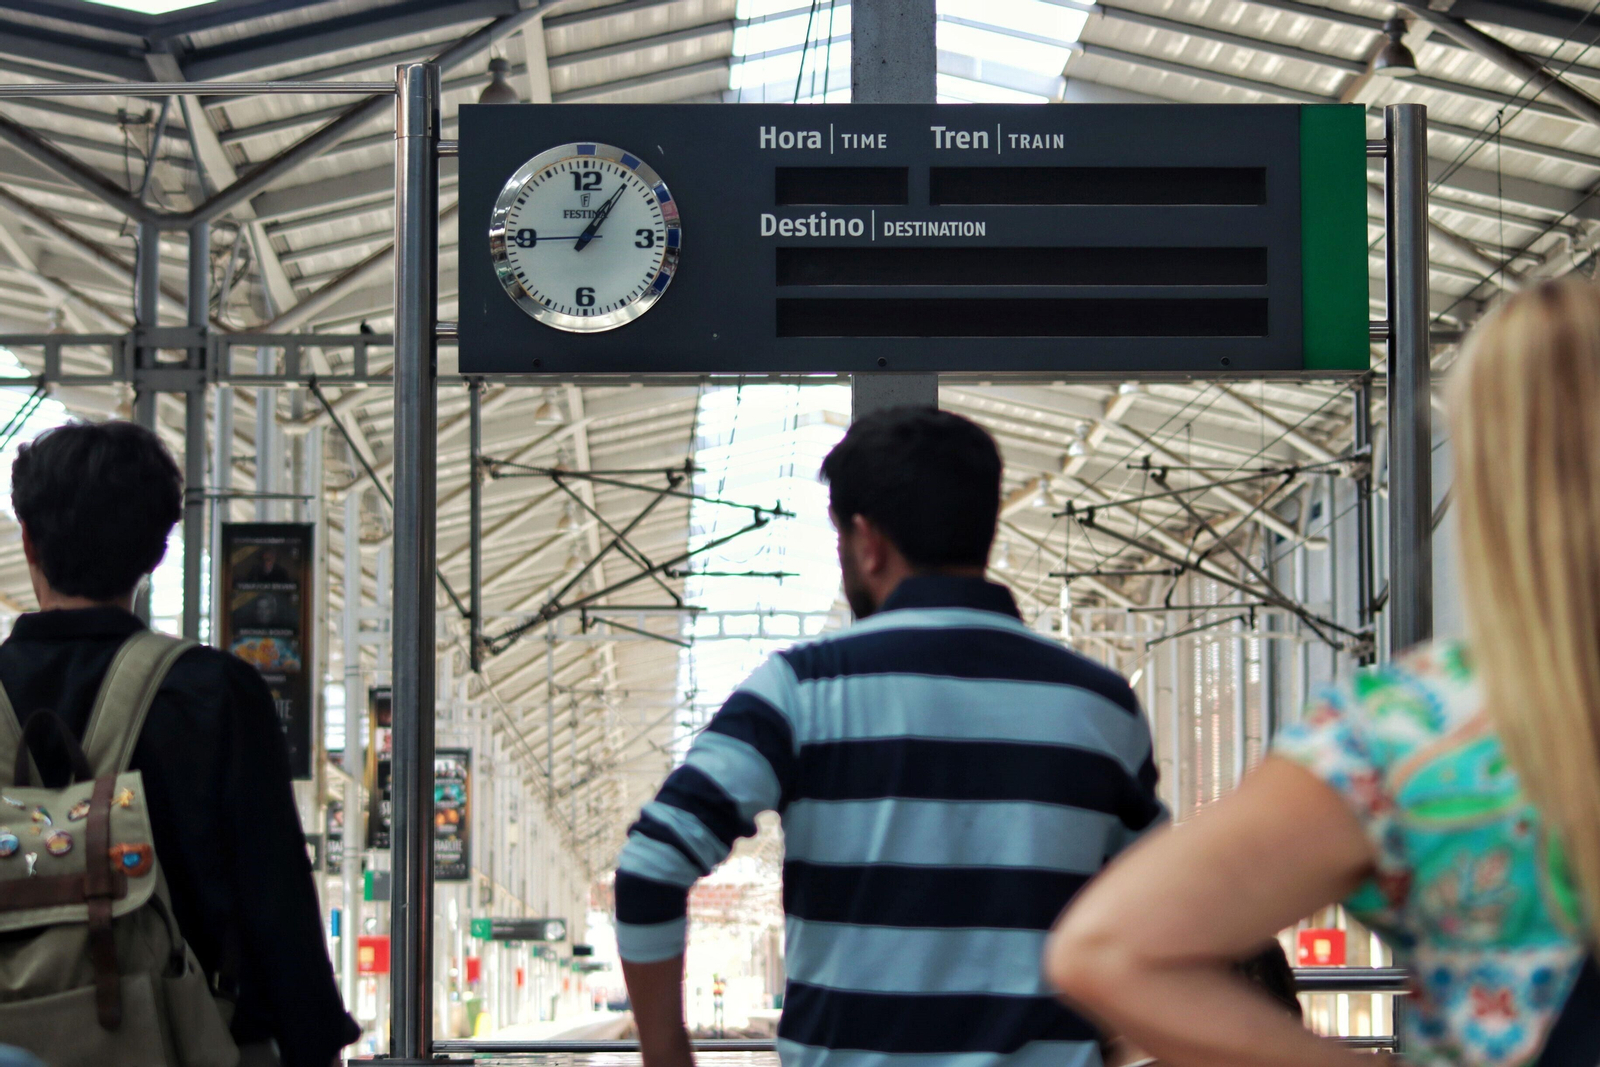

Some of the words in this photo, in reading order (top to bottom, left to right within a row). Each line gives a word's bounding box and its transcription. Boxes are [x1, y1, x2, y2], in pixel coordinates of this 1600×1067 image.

[760, 126, 822, 149] Hora
[841, 134, 888, 149] TIME
[930, 126, 989, 149] Tren
[1008, 134, 1065, 149] TRAIN
[570, 171, 602, 191] 12
[760, 211, 865, 237] Destino
[883, 221, 986, 237] DESTINATION
[517, 228, 537, 248] 9
[634, 228, 655, 249] 3
[575, 287, 595, 307] 6
